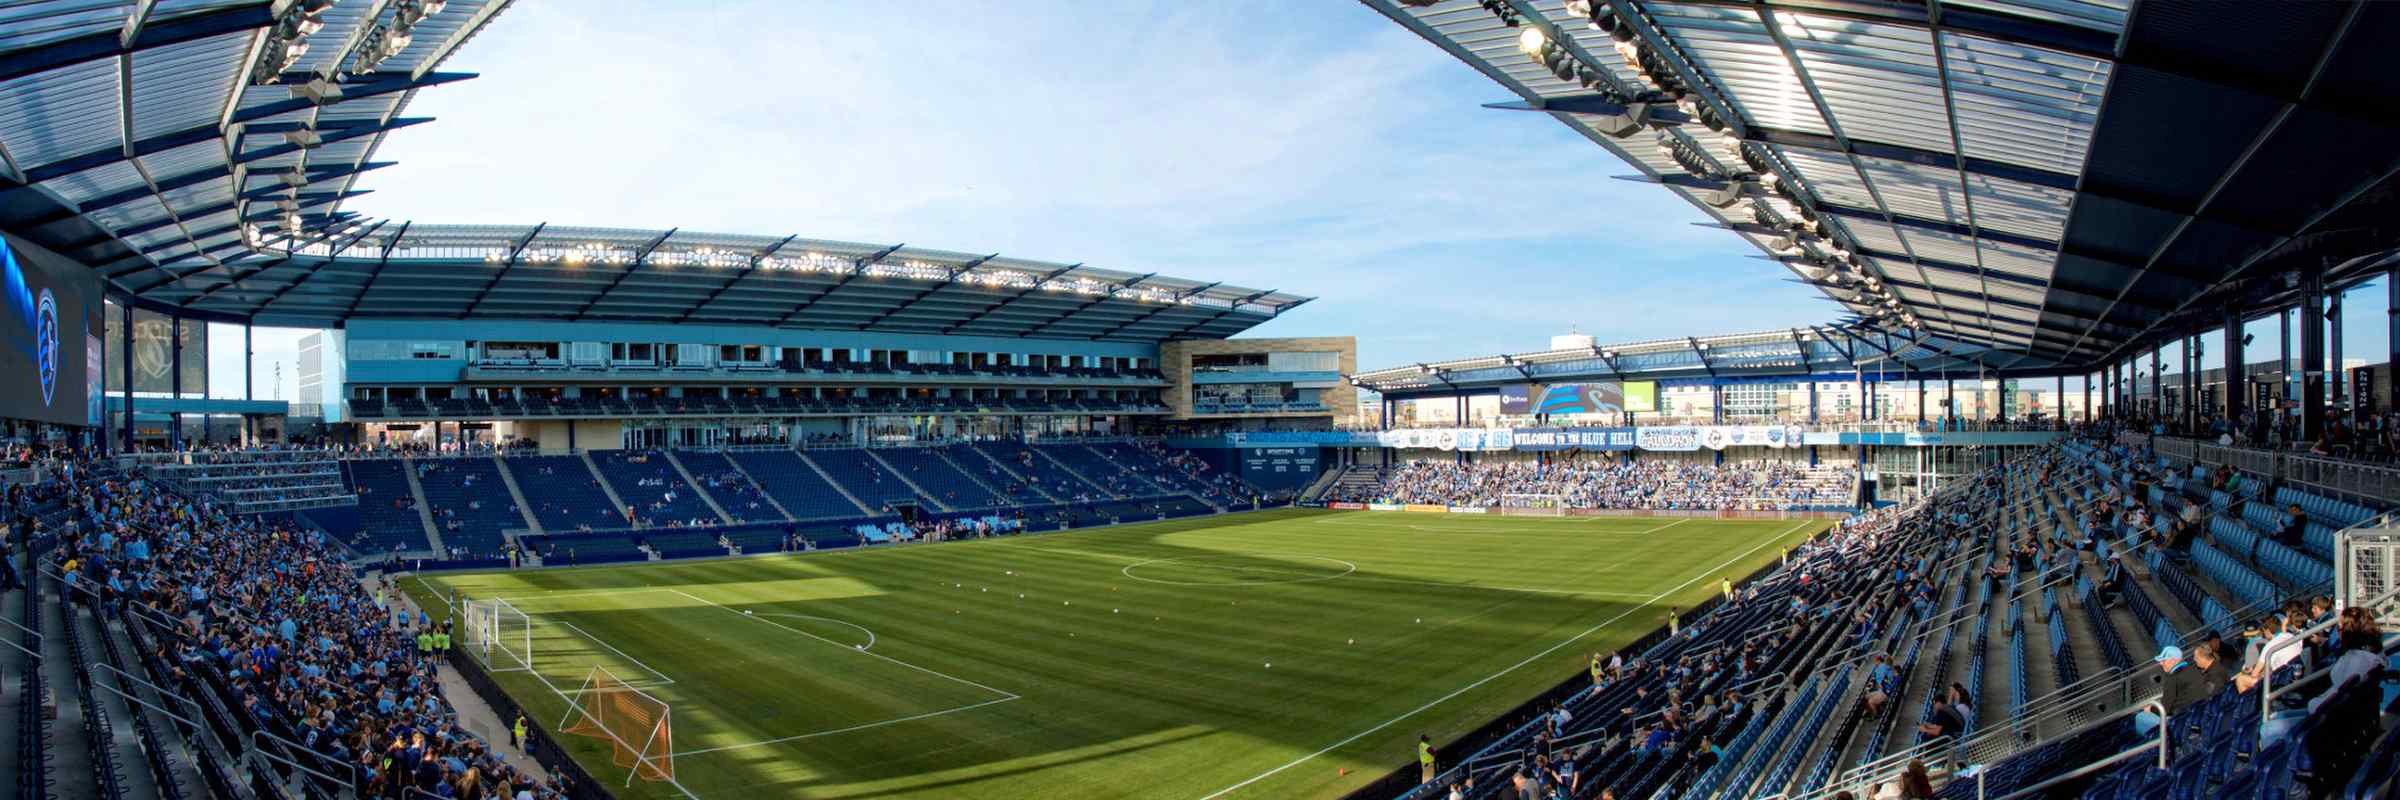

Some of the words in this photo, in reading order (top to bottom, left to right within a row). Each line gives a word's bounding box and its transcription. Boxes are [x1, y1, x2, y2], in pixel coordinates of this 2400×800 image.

[1514, 433, 1555, 445] WELCOME
[1582, 433, 1606, 446] BLUE
[1610, 432, 1634, 446] HELL
